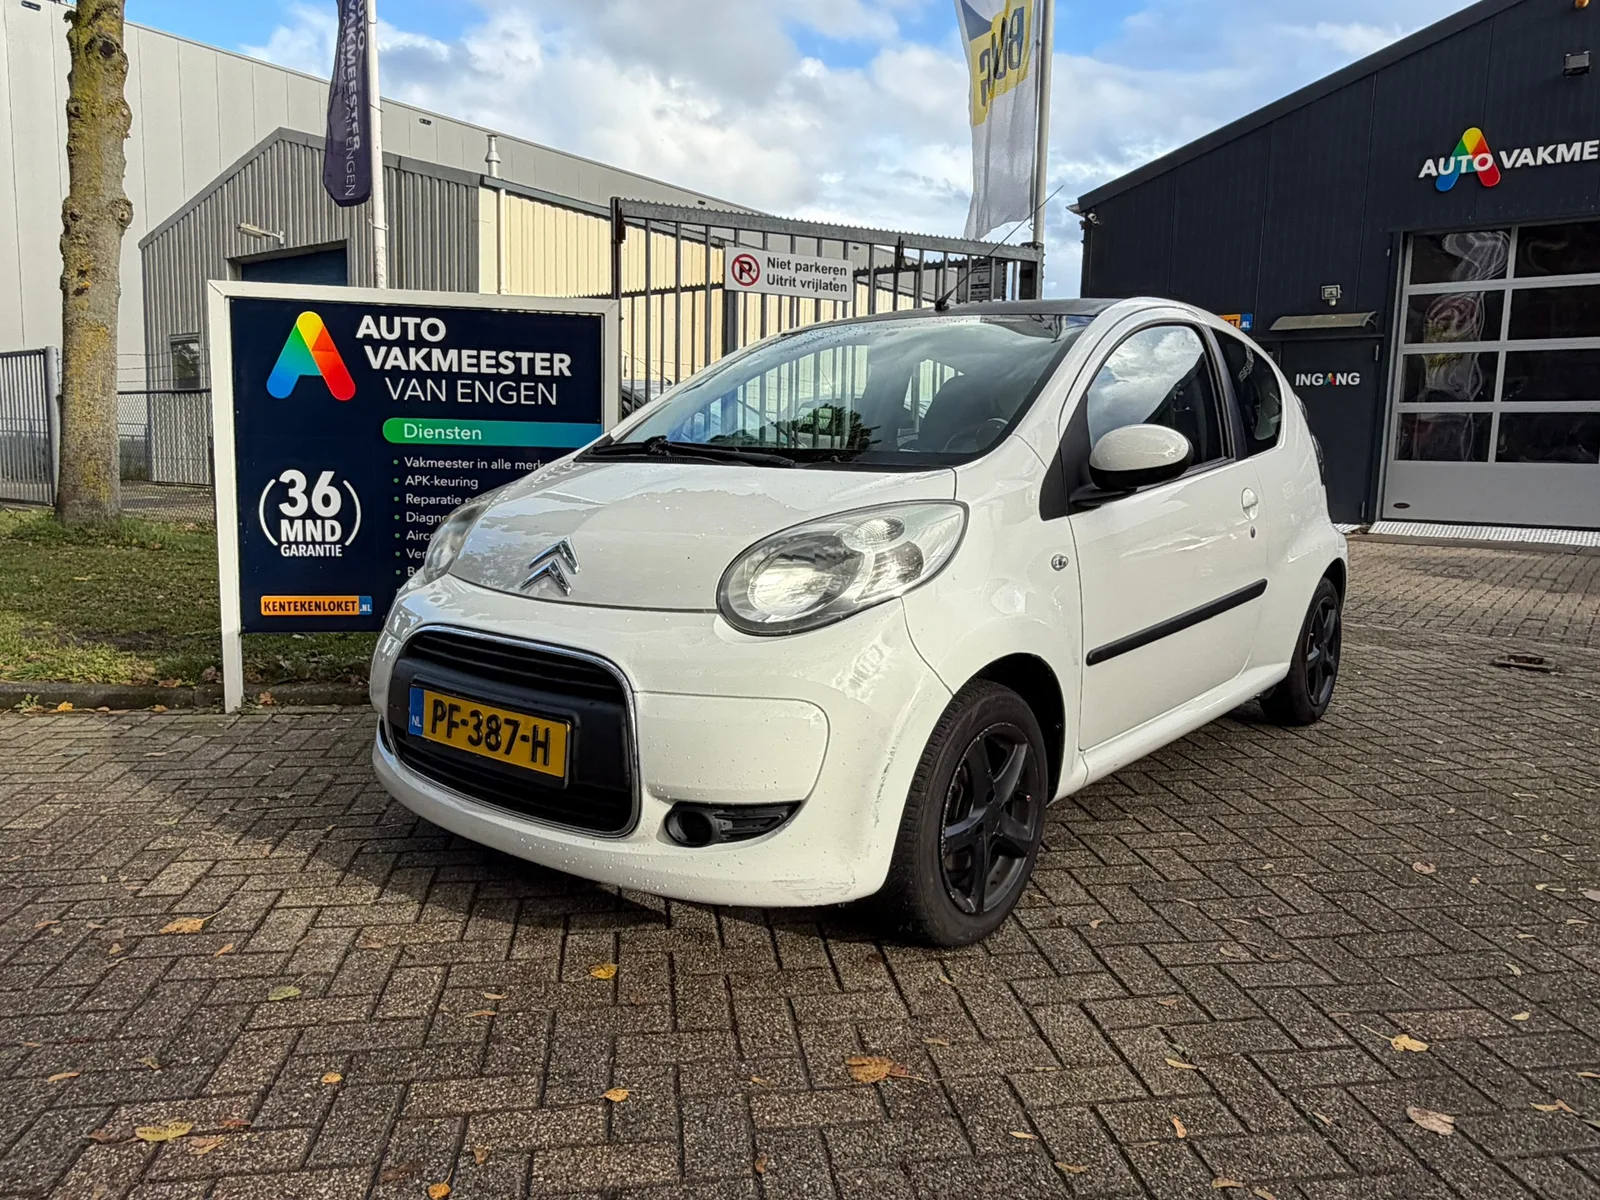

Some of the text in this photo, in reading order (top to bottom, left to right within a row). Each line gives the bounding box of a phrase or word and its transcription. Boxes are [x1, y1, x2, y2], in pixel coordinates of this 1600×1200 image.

[1418, 140, 1600, 178] AUTO VAKME
[767, 257, 847, 276] Niet parkeren
[766, 273, 848, 293] Uitrit vrijlaten
[356, 315, 447, 342] AUTO
[363, 345, 572, 377] VAKMEESTER
[1295, 372, 1361, 387] INGANG
[384, 377, 557, 405] VAN ENGEN
[403, 423, 482, 441] Diensten
[404, 457, 475, 469] Vakmeester
[477, 458, 488, 469] in
[491, 457, 512, 470] alle
[405, 475, 479, 490] APK-keuring
[278, 469, 342, 518] 36
[405, 493, 462, 507] Reparatie
[280, 519, 342, 543] MND
[280, 544, 343, 557] GARANTIE
[411, 698, 551, 766] NL PF-387-H
